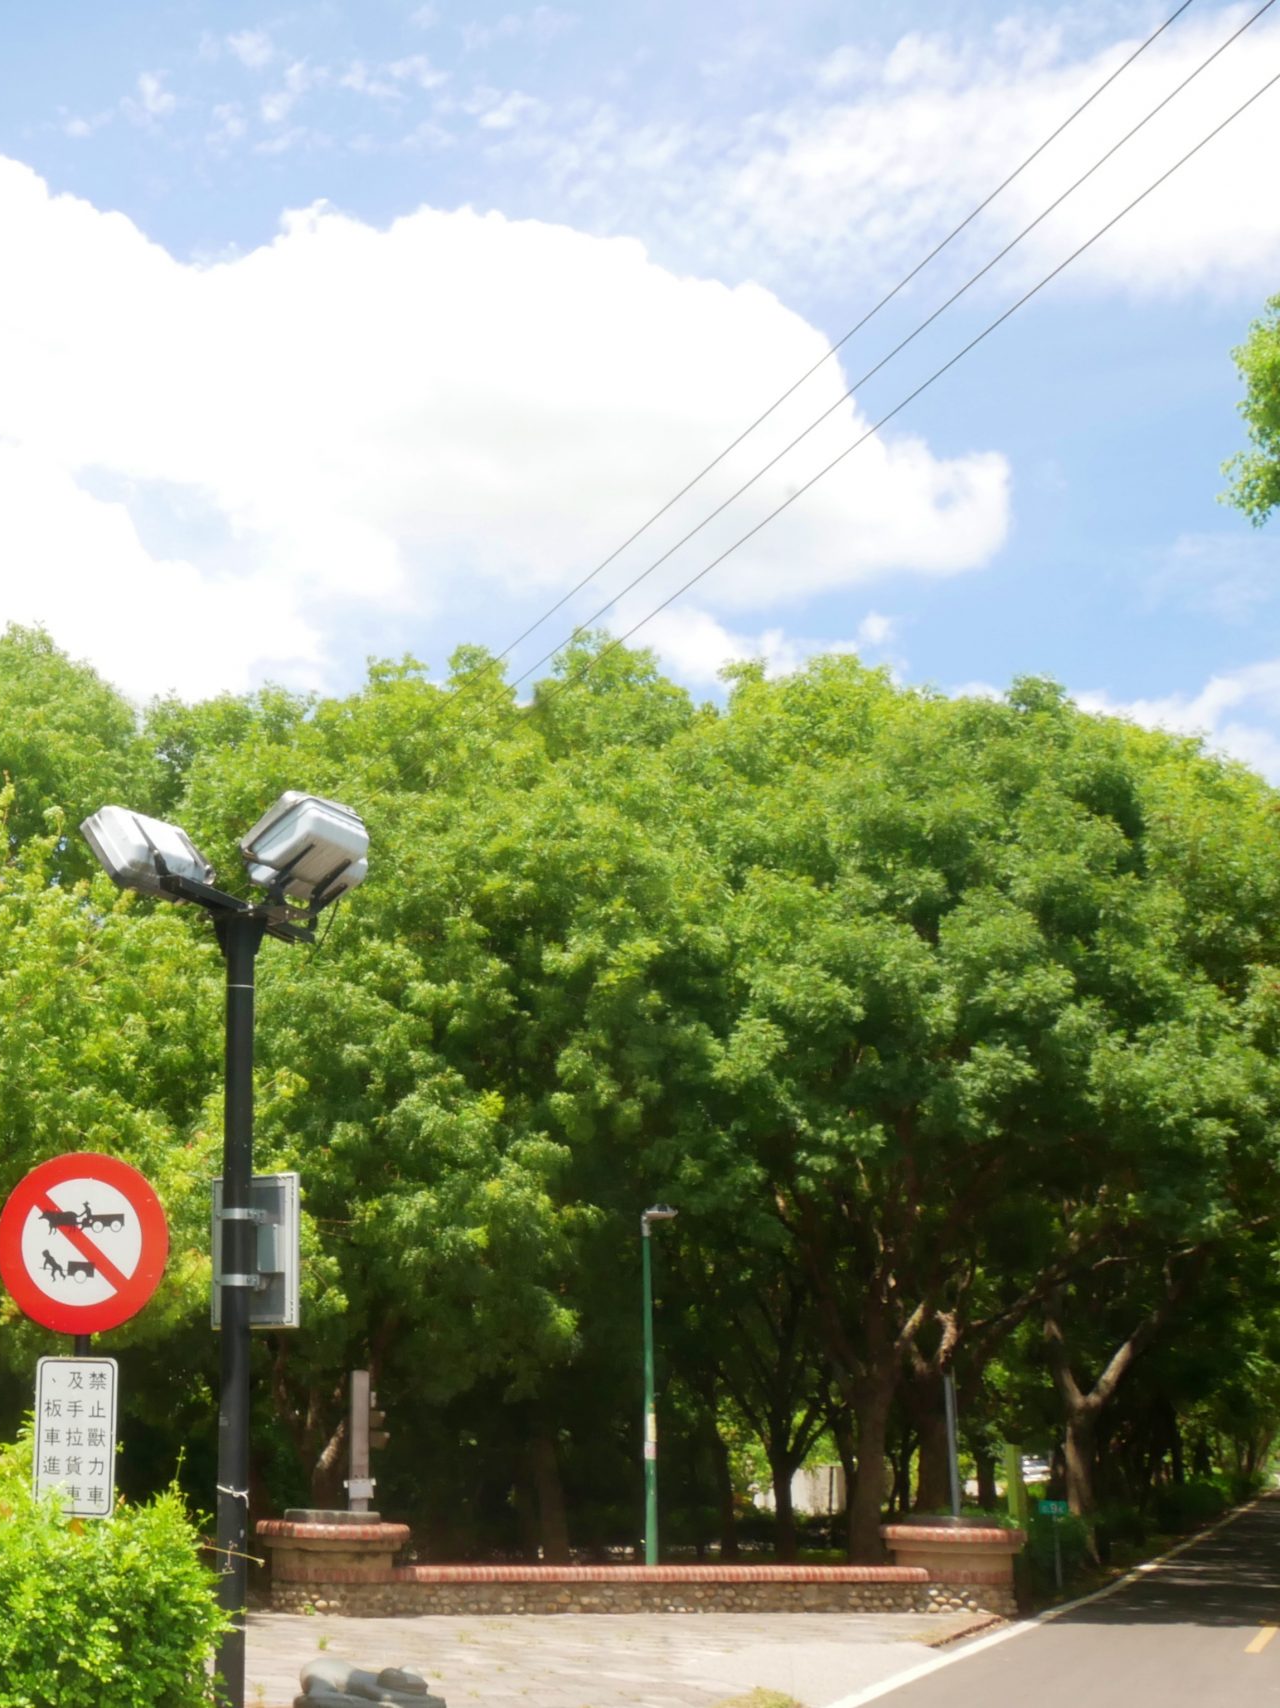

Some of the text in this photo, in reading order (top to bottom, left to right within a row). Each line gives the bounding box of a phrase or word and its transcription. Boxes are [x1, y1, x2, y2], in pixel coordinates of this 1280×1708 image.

[43, 1377, 62, 1503] 、板車進
[65, 1371, 84, 1505] 及手拉貨車
[87, 1371, 107, 1505] 禁止獸力車
